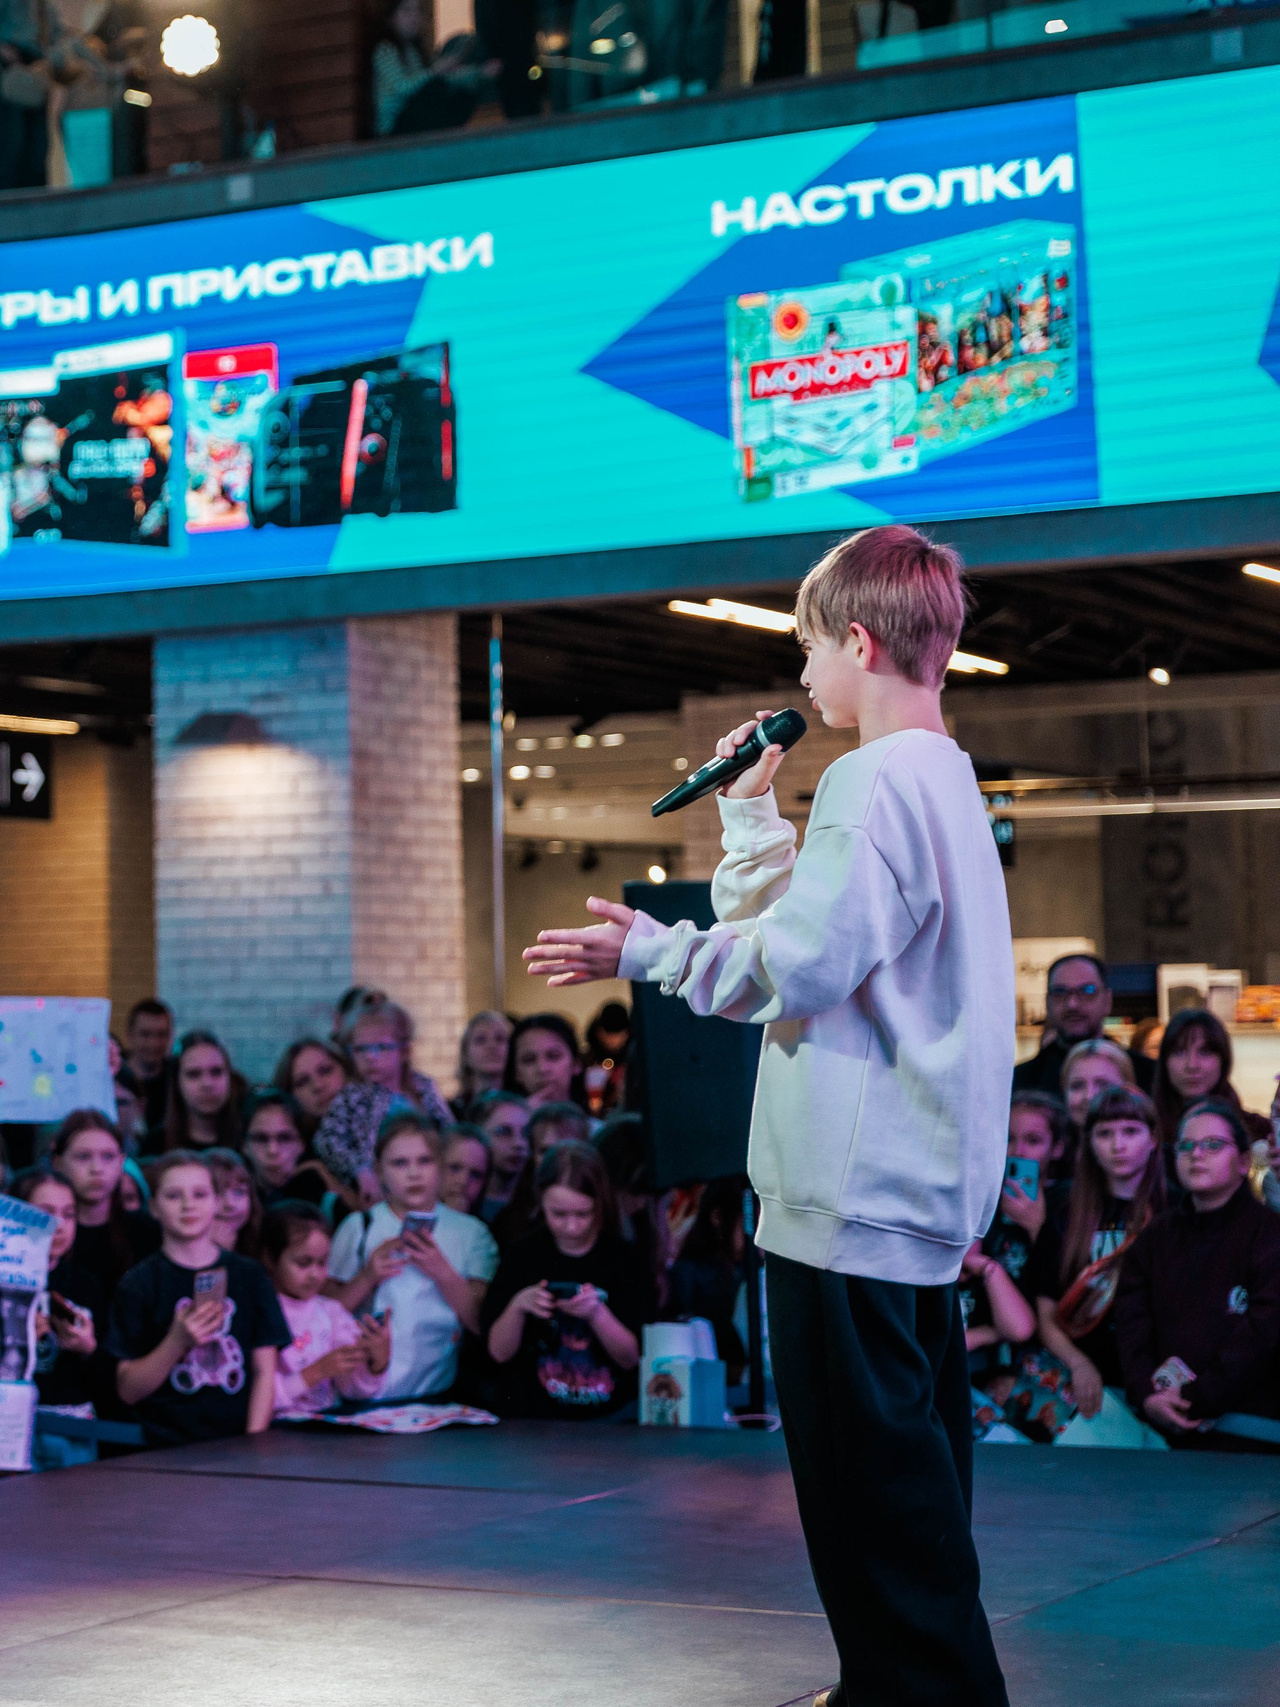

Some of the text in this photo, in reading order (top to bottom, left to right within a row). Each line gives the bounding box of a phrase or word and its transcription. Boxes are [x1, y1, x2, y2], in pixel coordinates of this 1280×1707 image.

[711, 153, 1074, 237] НАСТОЛКИ
[99, 281, 138, 320] И
[148, 232, 494, 311] ПРИСТАВКИ
[754, 346, 906, 395] MONOPOLY
